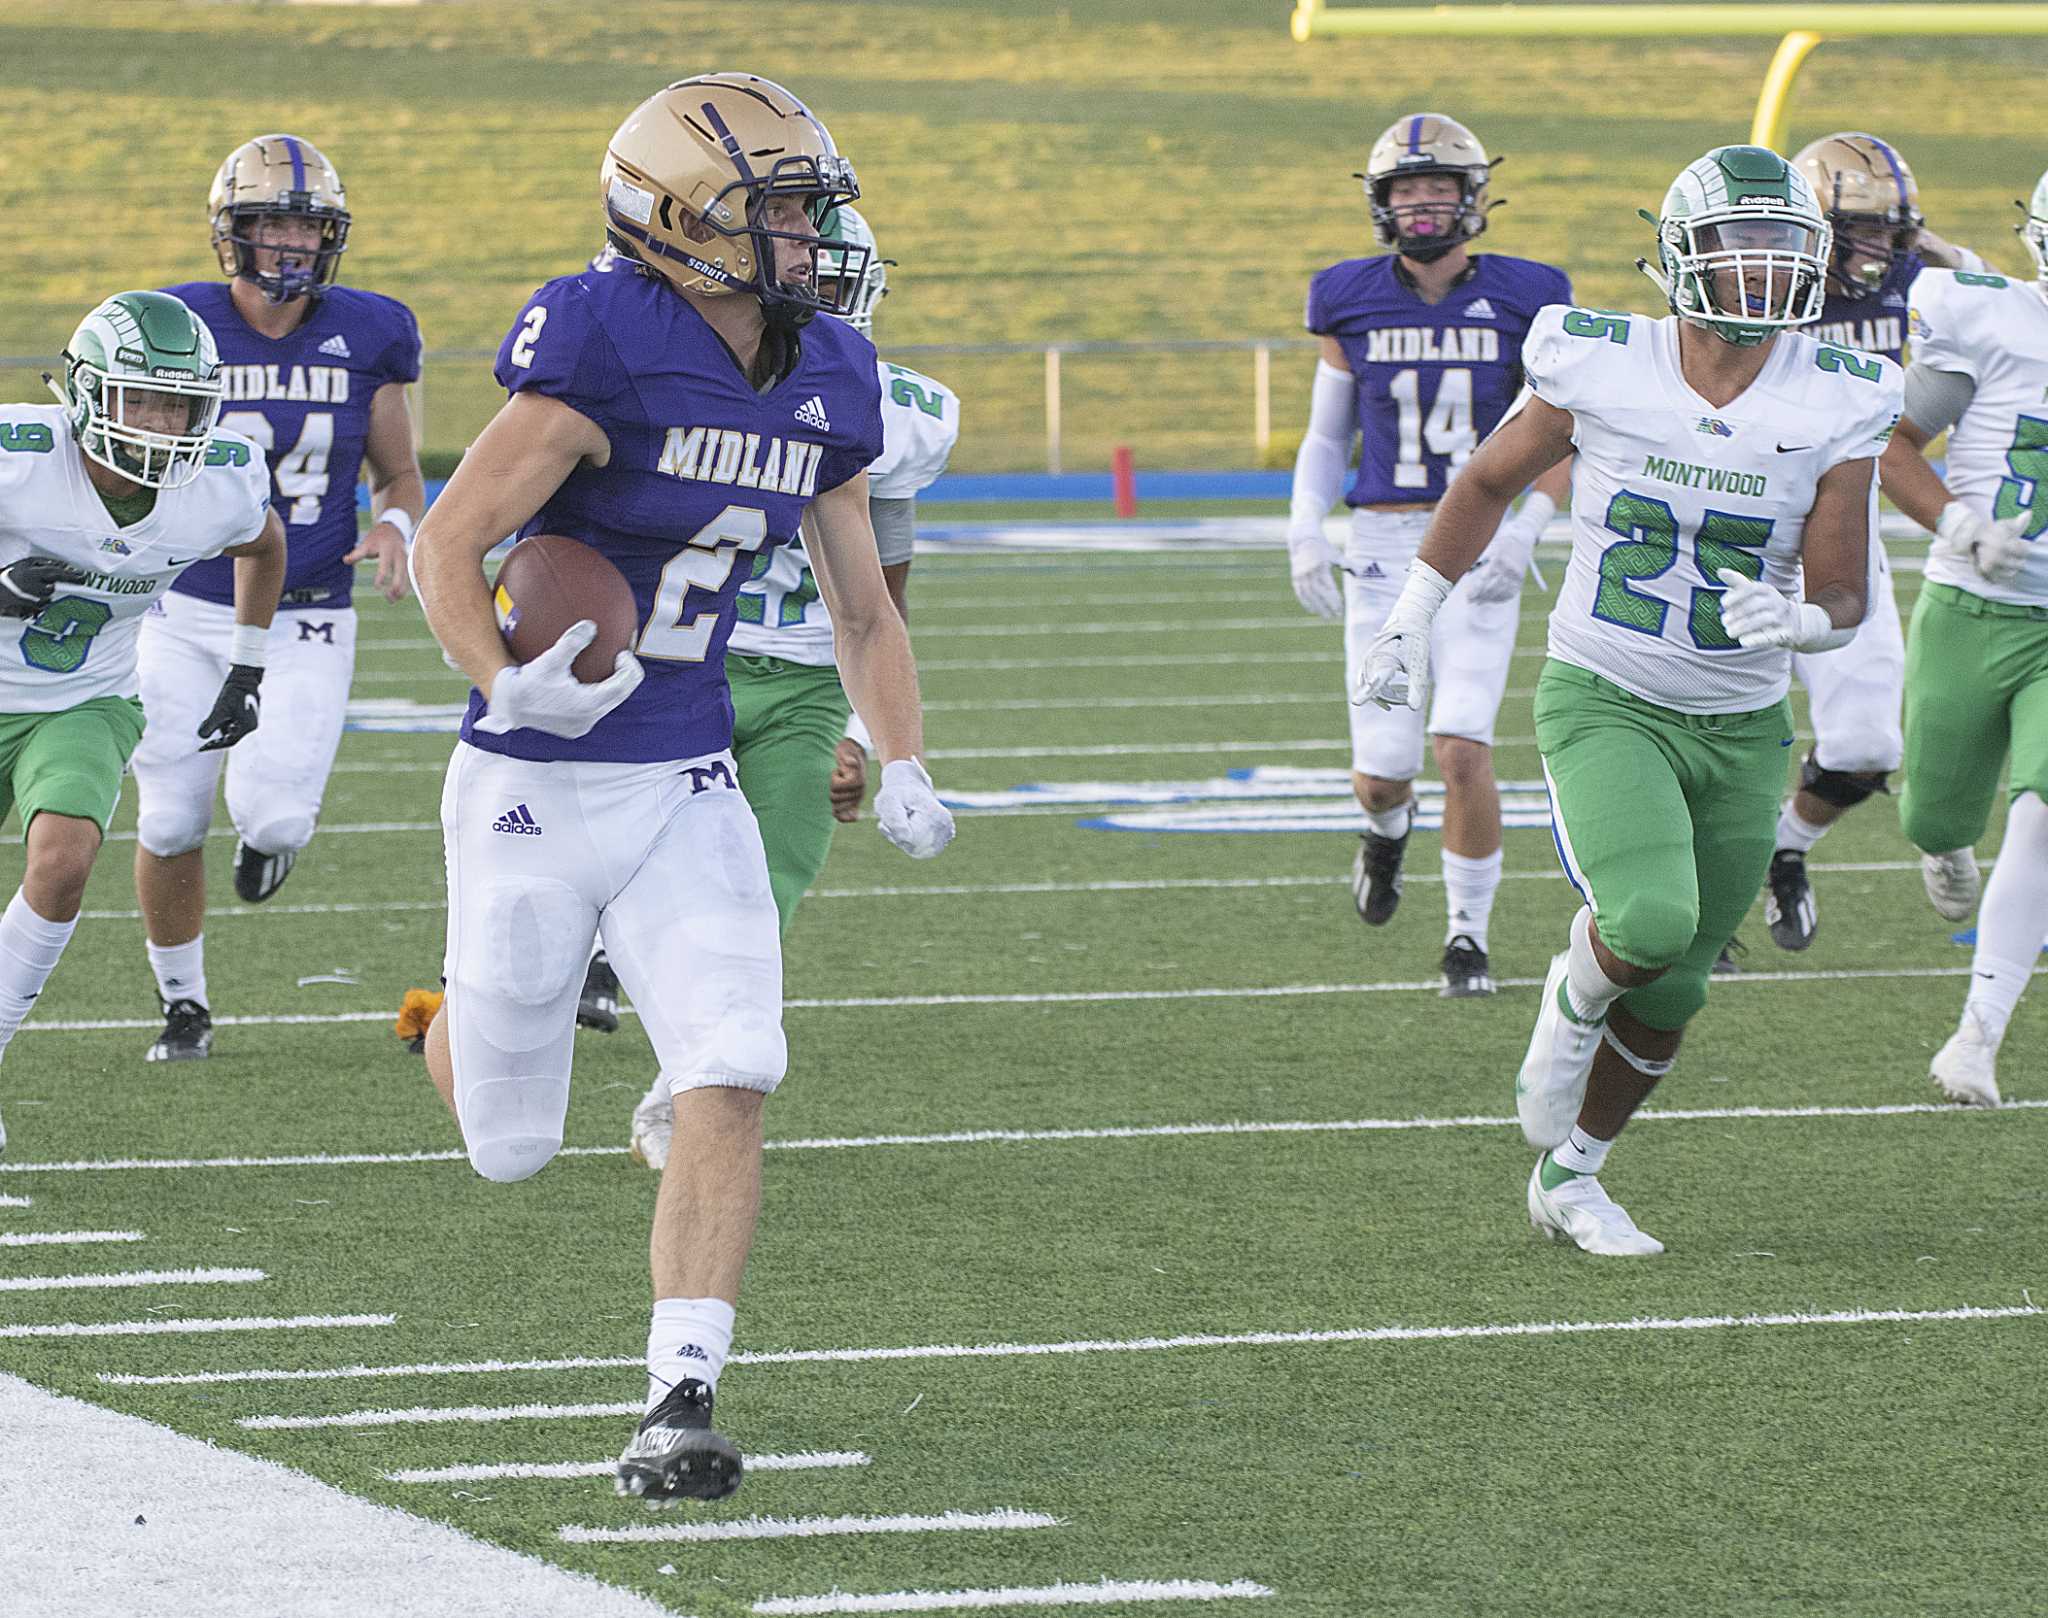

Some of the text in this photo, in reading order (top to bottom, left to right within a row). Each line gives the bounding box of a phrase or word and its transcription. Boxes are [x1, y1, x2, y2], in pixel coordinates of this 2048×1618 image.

[511, 305, 548, 369] 2
[1366, 328, 1499, 362] MIDLAND
[794, 410, 830, 432] adidas
[1390, 369, 1476, 488] 14
[1641, 454, 1768, 498] MONTWOOD
[636, 505, 768, 662] 2
[1591, 489, 1776, 651] 25
[18, 595, 113, 674] 9
[297, 620, 335, 645] M
[678, 761, 737, 795] M
[492, 820, 542, 836] adidas
